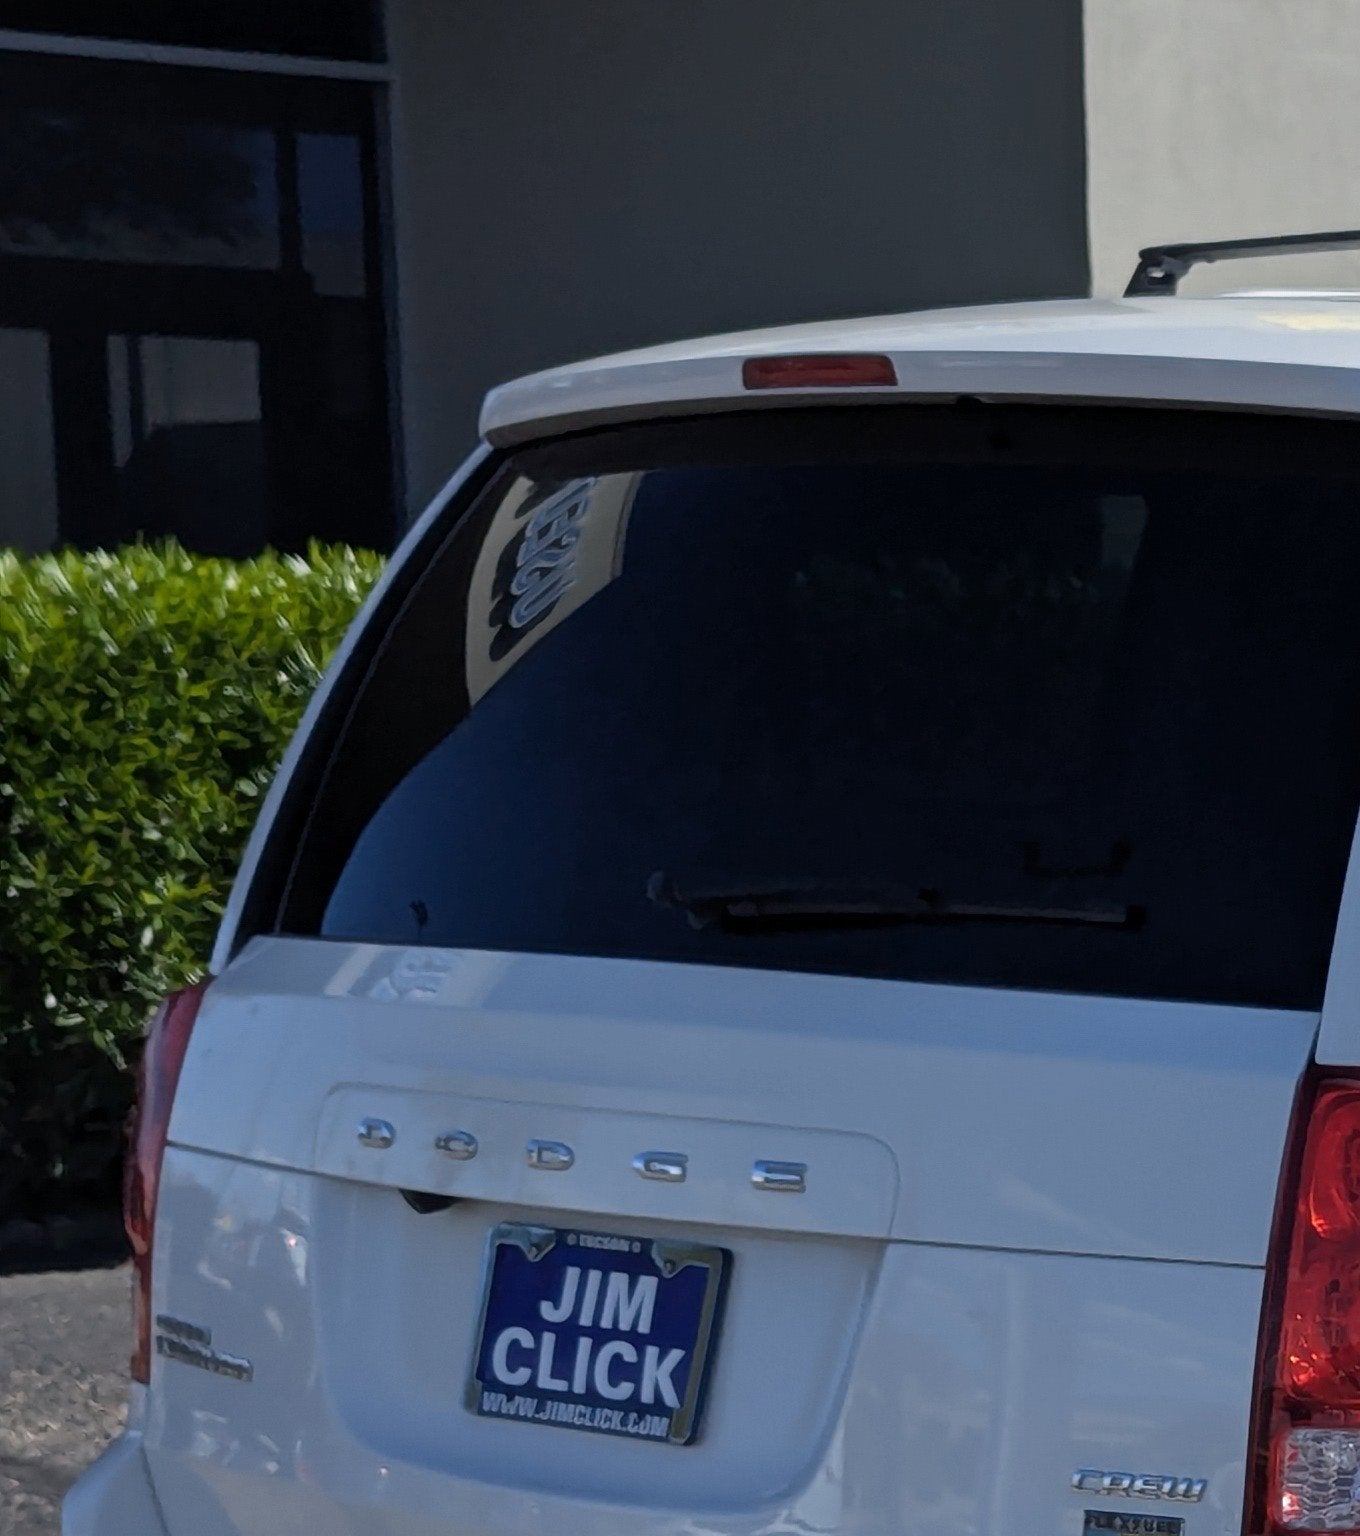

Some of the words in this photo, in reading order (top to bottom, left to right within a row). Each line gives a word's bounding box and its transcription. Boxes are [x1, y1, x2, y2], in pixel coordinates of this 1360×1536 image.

[358, 1117, 807, 1192] DODGE
[539, 1265, 659, 1335] JIM
[492, 1326, 687, 1409] CLICK
[481, 1390, 670, 1437] WWW.JIMCLICK.COM
[1070, 1468, 1208, 1503] CREW
